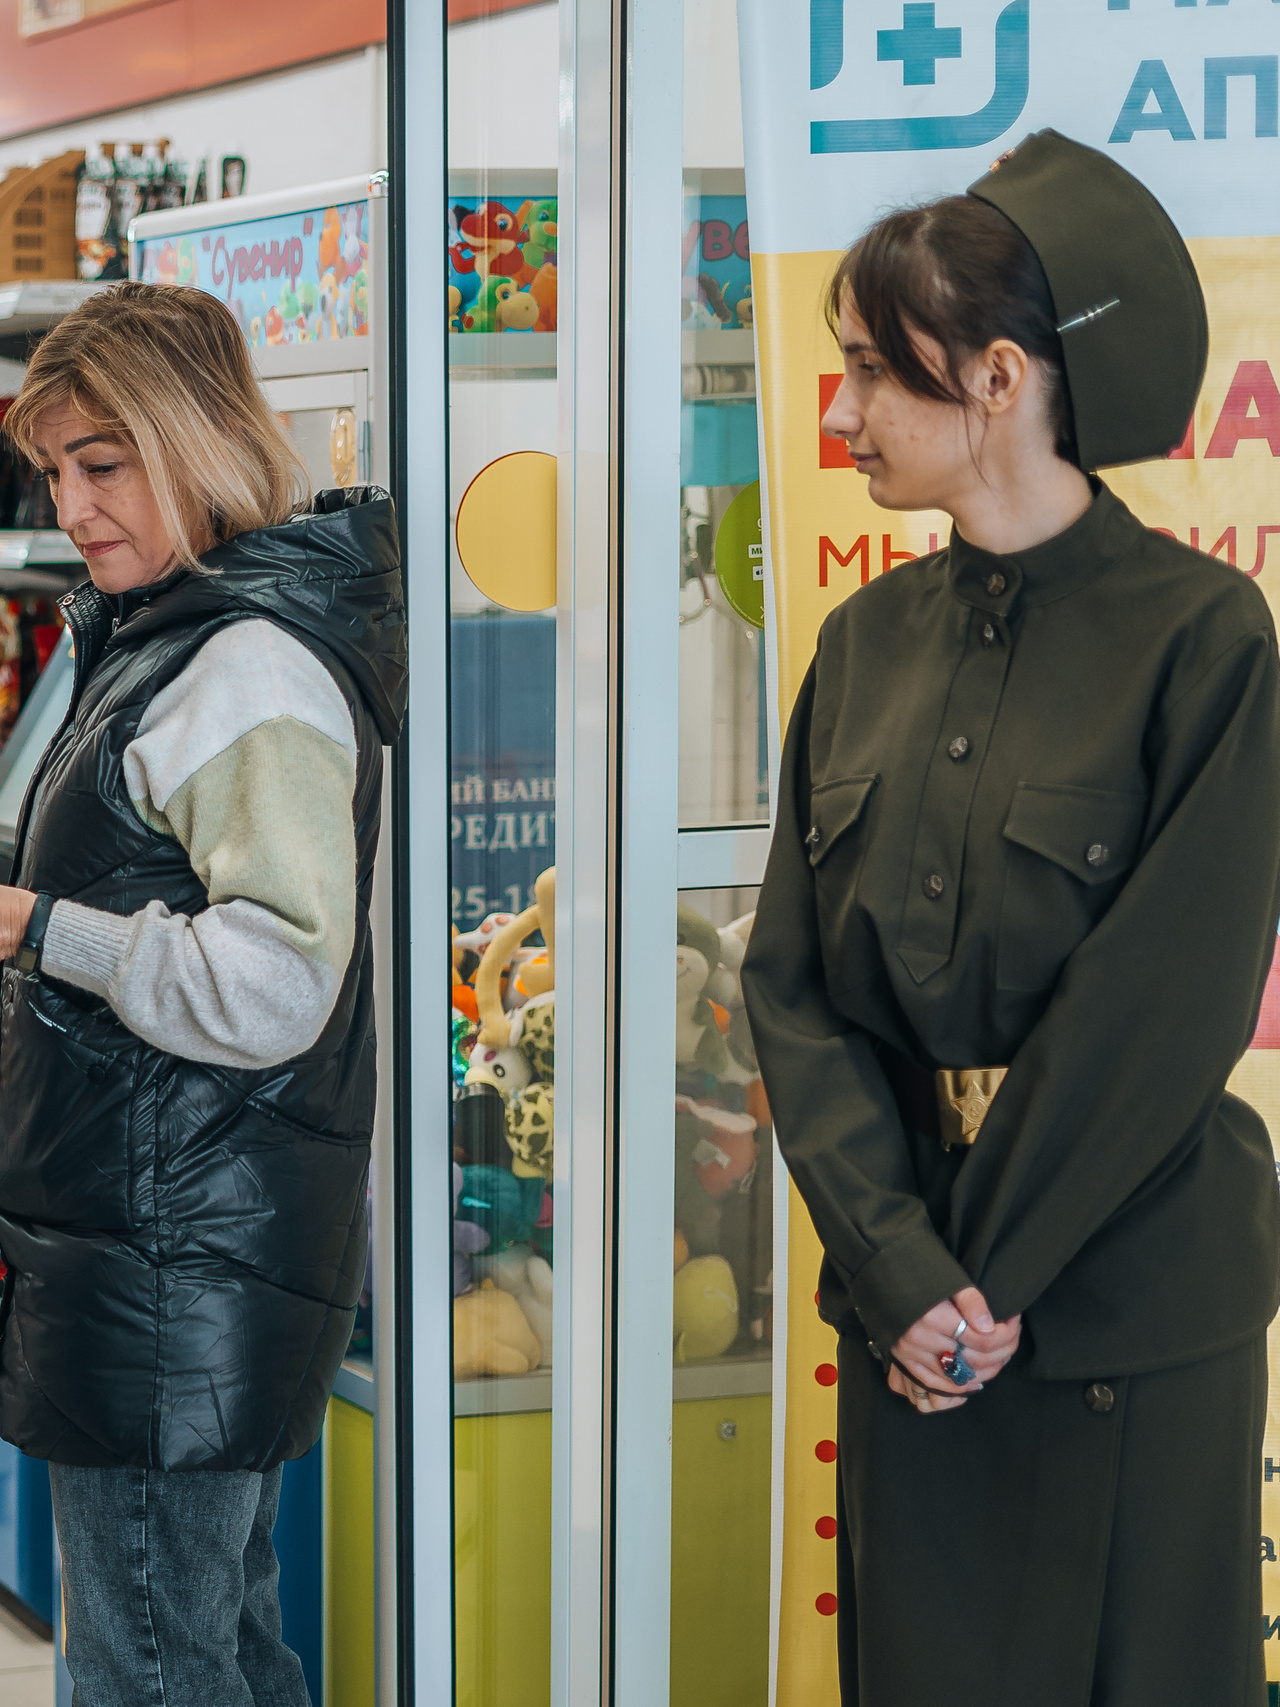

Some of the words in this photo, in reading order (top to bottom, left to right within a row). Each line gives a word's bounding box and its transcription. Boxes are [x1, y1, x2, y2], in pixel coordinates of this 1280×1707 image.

[1108, 55, 1279, 143] АП
[202, 217, 313, 299] "Сувенир"
[493, 778, 555, 803] БАН
